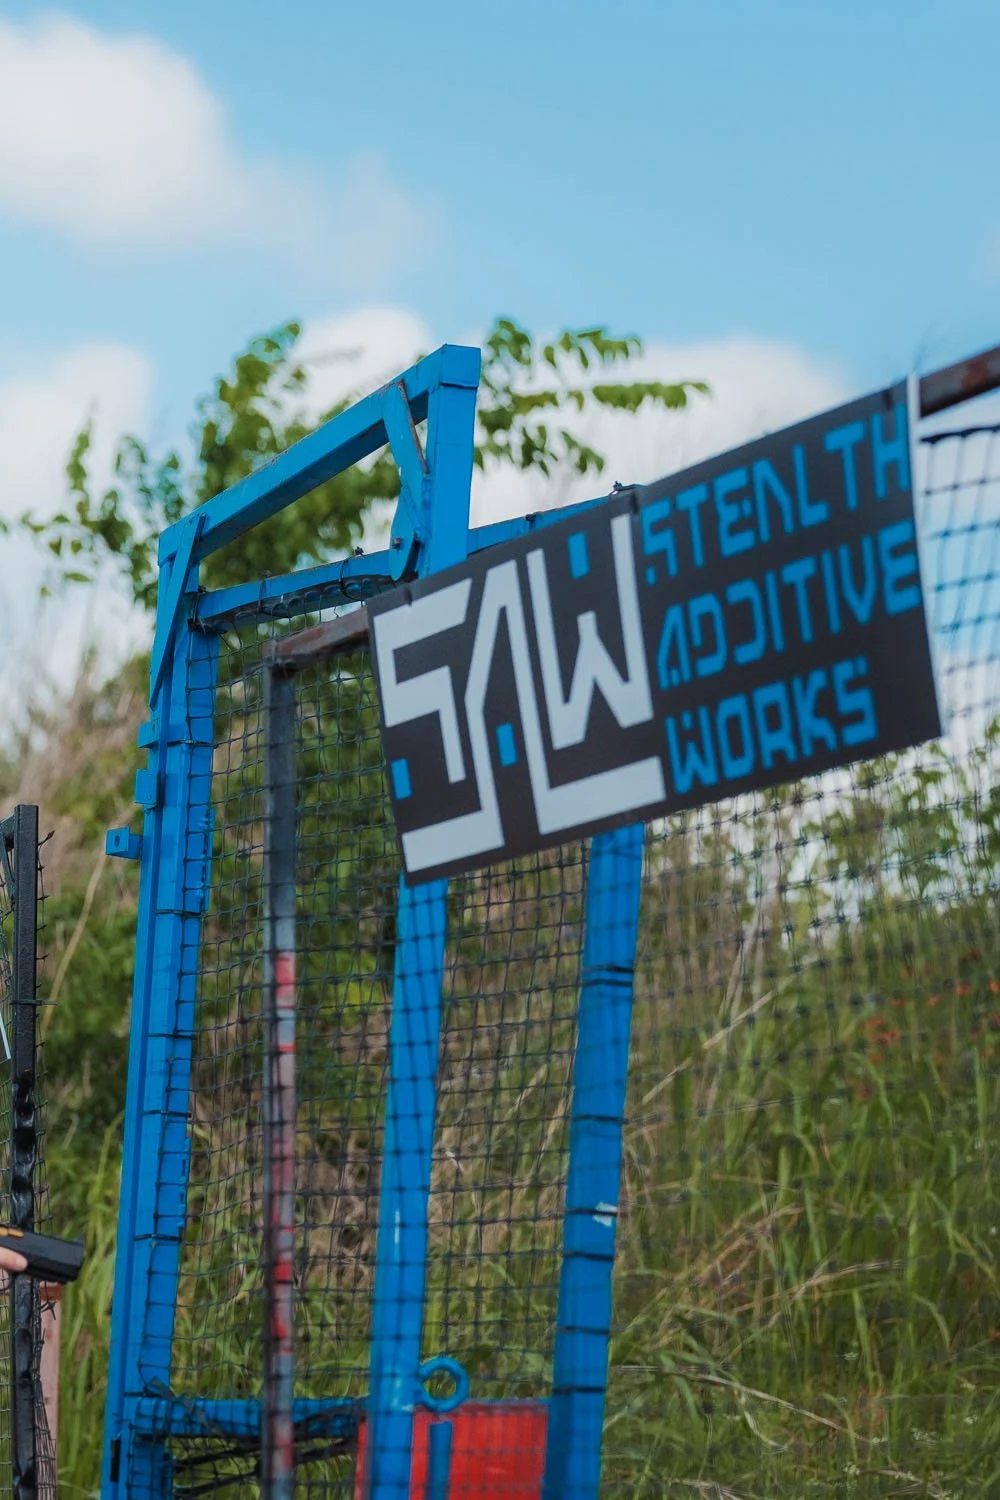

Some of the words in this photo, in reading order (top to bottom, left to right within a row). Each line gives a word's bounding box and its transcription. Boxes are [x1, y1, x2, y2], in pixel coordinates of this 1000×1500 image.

[643, 403, 911, 585] STEALTH
[658, 520, 921, 689] ADDITIVE
[667, 657, 878, 794] WORKS
